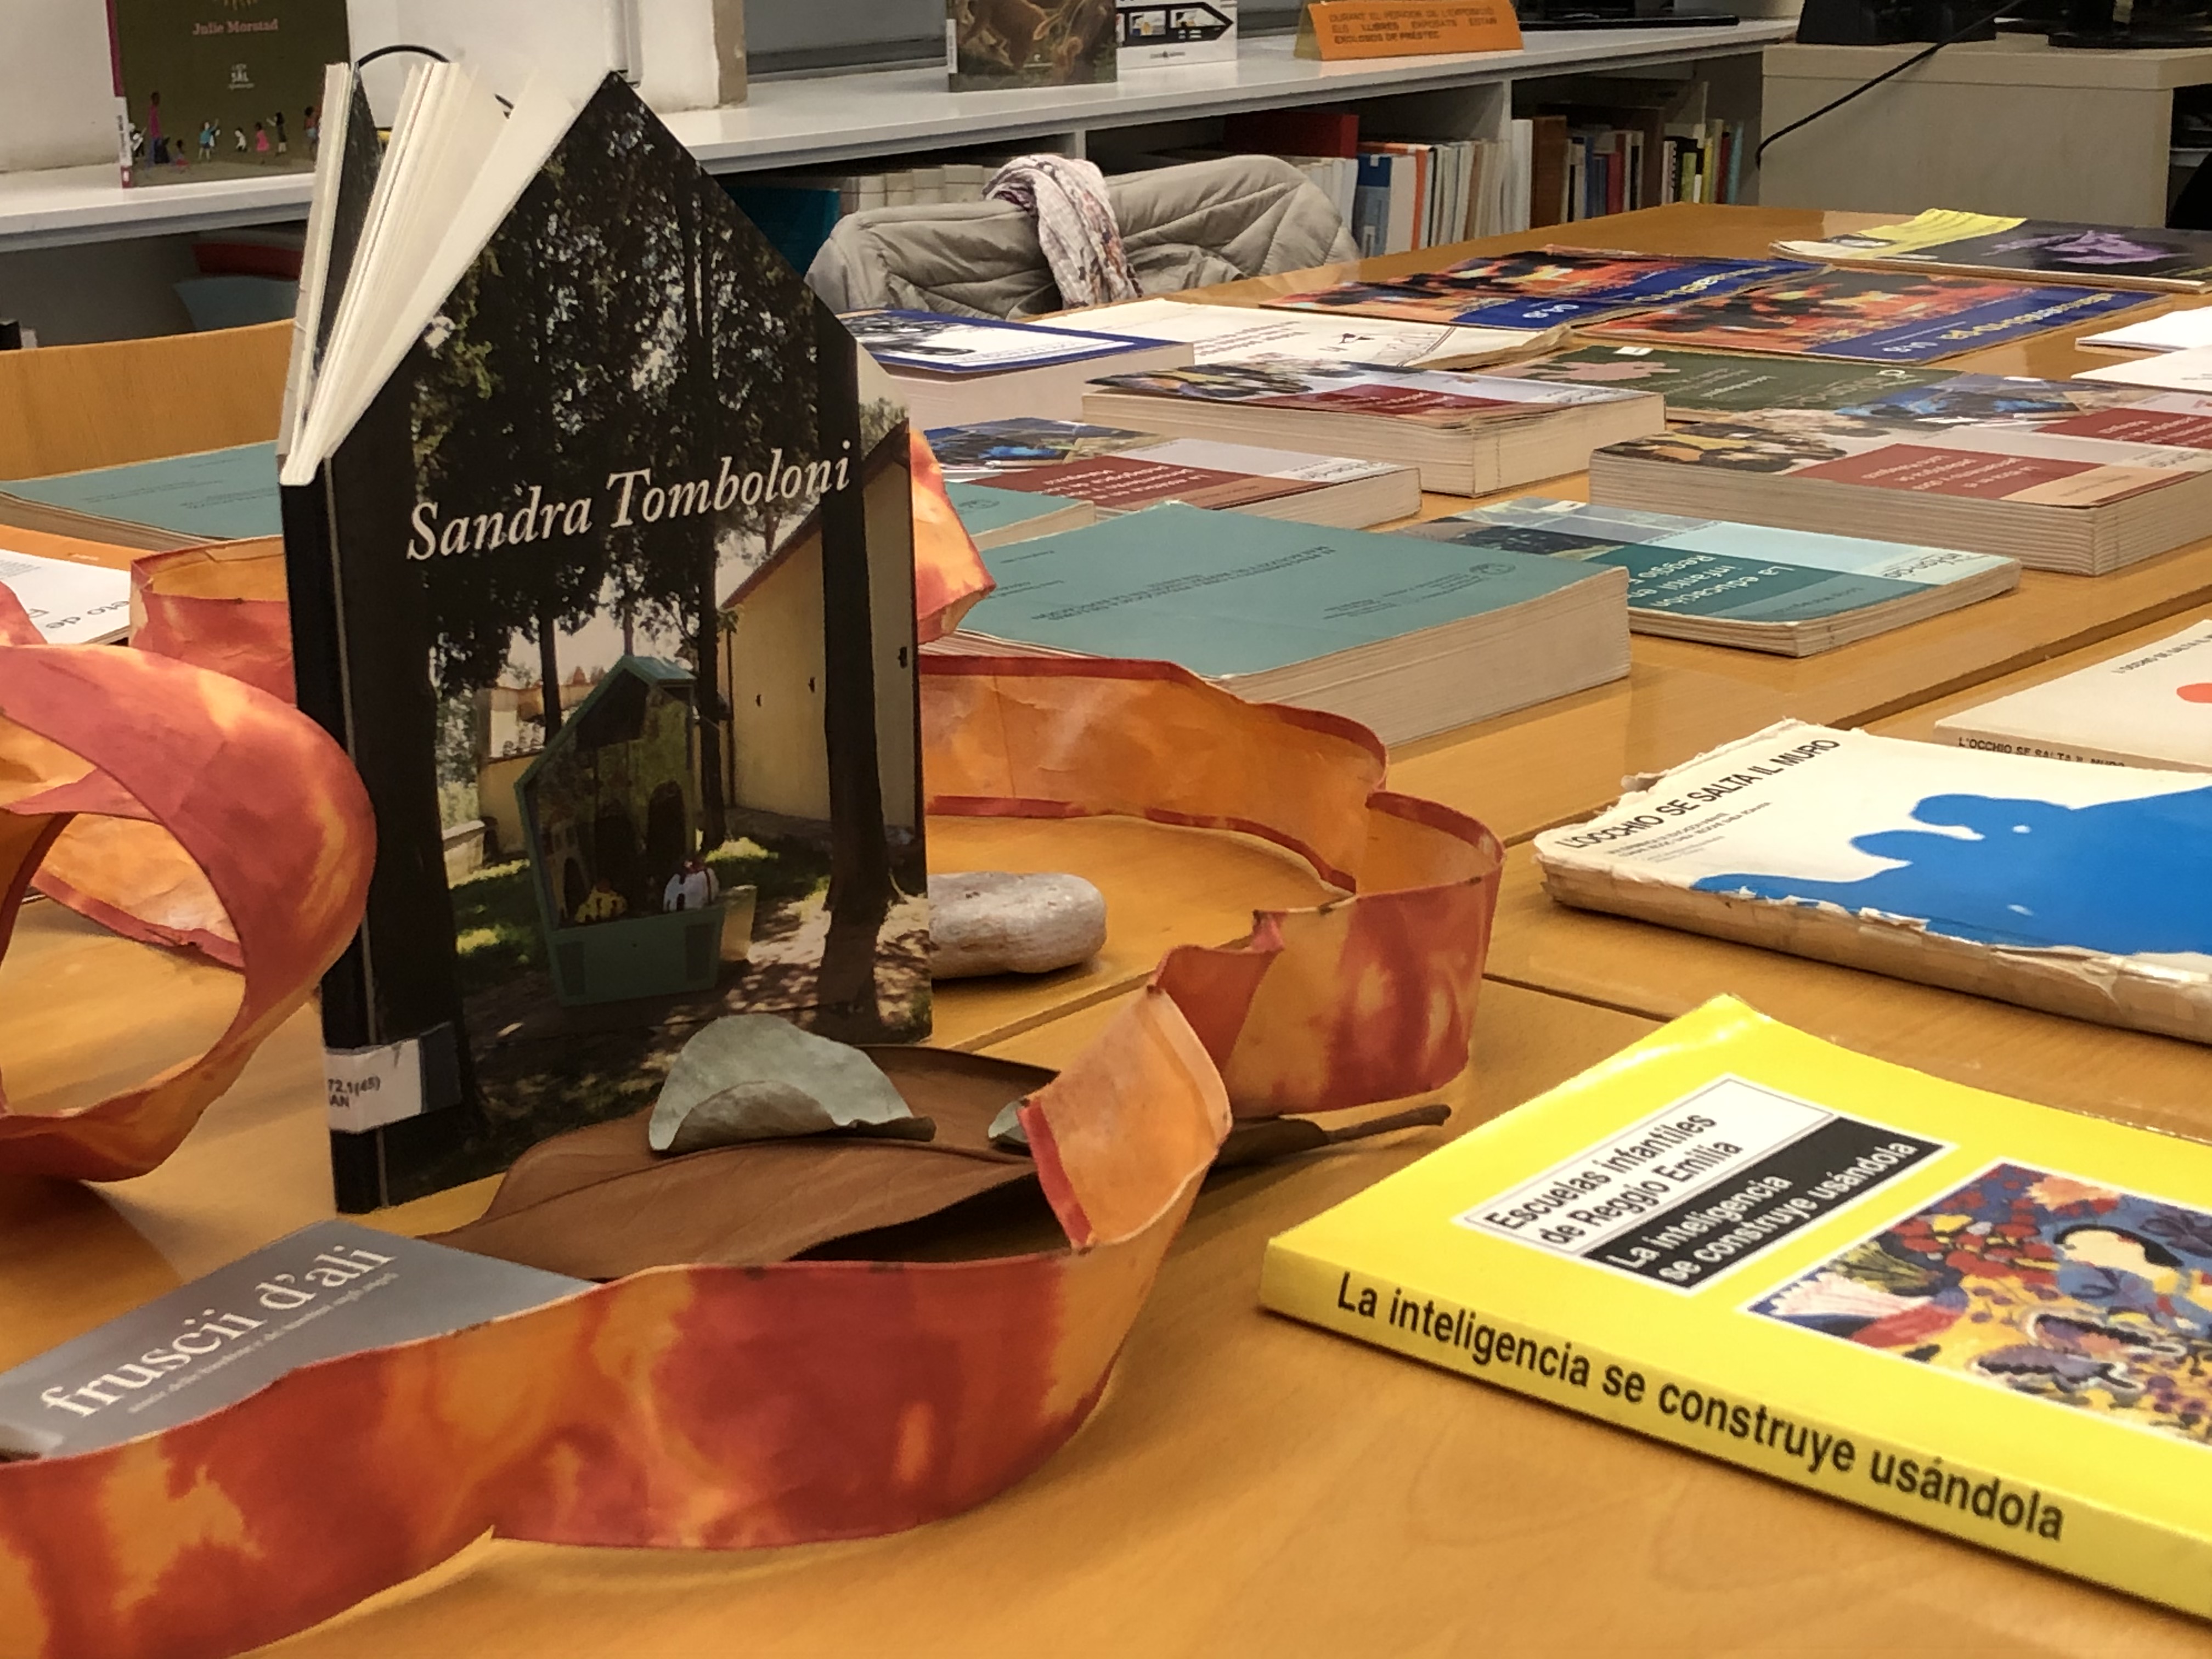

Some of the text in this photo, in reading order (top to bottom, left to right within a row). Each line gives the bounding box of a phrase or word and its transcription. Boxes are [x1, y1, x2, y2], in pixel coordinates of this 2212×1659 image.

[406, 439, 851, 561] Sandra Tomboloni
[1555, 815, 1664, 849] L'OCCHIO
[1656, 799, 1701, 816] SE
[1687, 774, 1757, 803] SALTA
[1744, 766, 1785, 776] IL
[1769, 738, 1841, 766] MURO
[1484, 1110, 1718, 1232] Escuelas infantiles
[1539, 1138, 1744, 1246] de Reggio Emilia
[1606, 1172, 1793, 1269] La inteligencia
[1658, 1139, 1919, 1283] se construye usándola
[40, 1308, 267, 1418] fruscii
[255, 1244, 399, 1311] d'ali
[1336, 1269, 2064, 1542] La inteligencia se construye usándola
